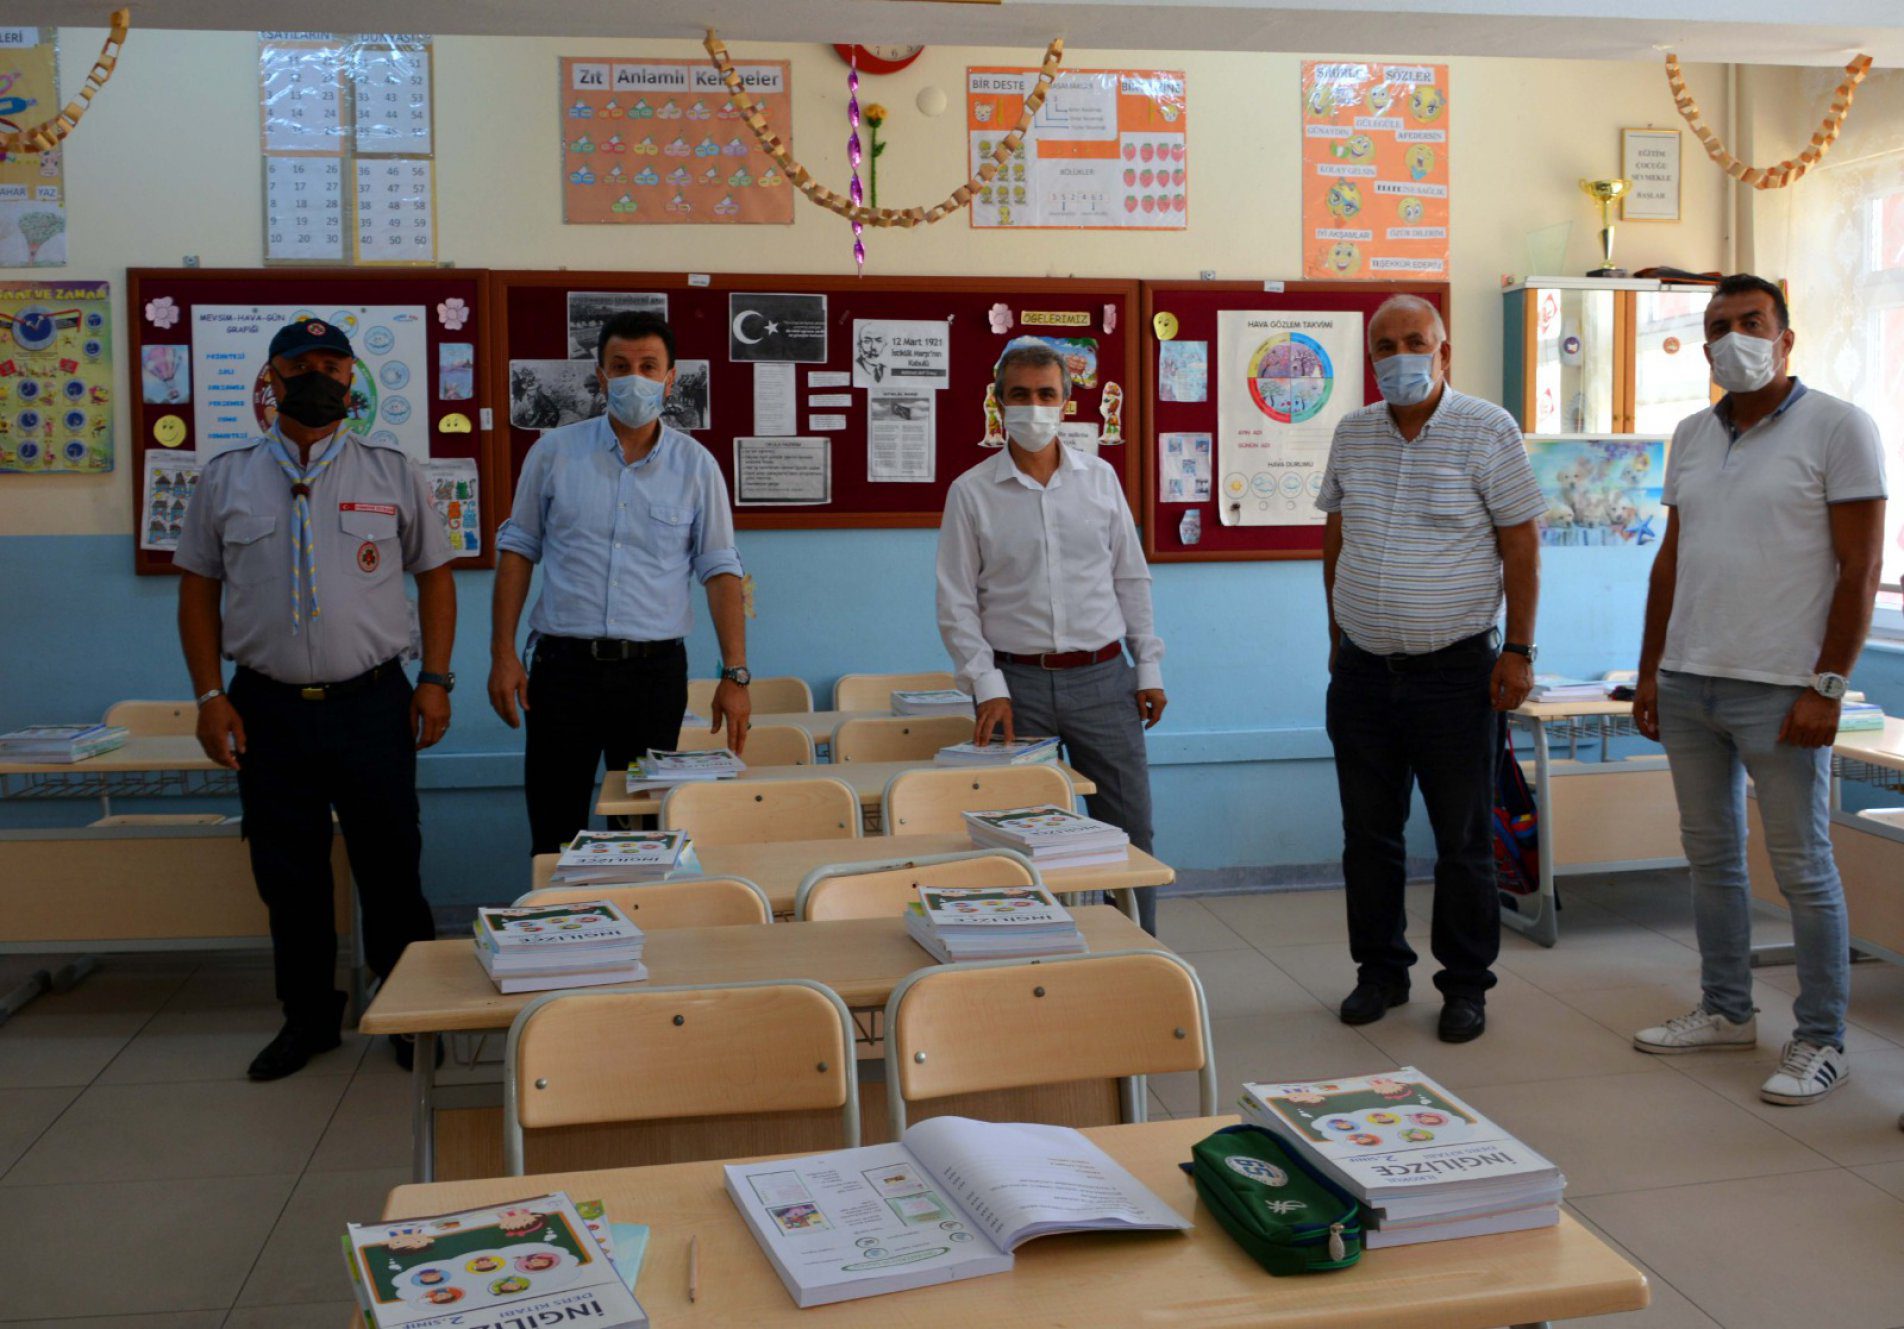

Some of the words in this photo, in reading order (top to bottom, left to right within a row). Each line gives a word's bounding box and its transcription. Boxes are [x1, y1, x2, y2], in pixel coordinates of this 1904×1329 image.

[411, 76, 422, 85] 52
[972, 79, 989, 89] BİR
[993, 80, 1024, 90] DESTE
[322, 92, 334, 100] 23
[358, 93, 369, 101] 33
[385, 93, 396, 101] 43
[411, 93, 423, 101] 53
[291, 110, 302, 118] 14
[324, 110, 336, 118] 24
[358, 110, 370, 118] 34
[385, 110, 397, 119] 44
[411, 111, 423, 119] 54
[269, 165, 275, 174] 6
[293, 165, 304, 174] 16
[326, 165, 338, 174] 26
[359, 167, 370, 176] 36
[386, 167, 399, 176] 46
[412, 167, 424, 176] 56
[270, 182, 276, 191] 7
[295, 182, 306, 191] 17
[326, 182, 338, 191] 27
[359, 184, 370, 193] 37
[387, 184, 399, 193] 47
[413, 184, 425, 193] 57
[270, 200, 276, 208] 8
[296, 200, 307, 208] 18
[326, 200, 338, 208] 28
[360, 202, 371, 210] 38
[388, 202, 400, 210] 48
[414, 202, 425, 210] 58
[270, 217, 277, 226] 9
[296, 217, 308, 226] 19
[326, 217, 338, 226] 29
[360, 219, 371, 227] 39
[389, 219, 400, 227] 49
[414, 219, 426, 227] 59
[271, 234, 282, 243] 10
[298, 234, 310, 243] 20
[326, 234, 338, 243] 30
[360, 236, 372, 245] 40
[389, 236, 401, 245] 50
[414, 236, 427, 245] 60
[1270, 320, 1300, 328] GÖZLEM
[892, 337, 902, 346] 12
[903, 337, 922, 346] Mart
[925, 338, 943, 346] 1921
[1371, 1151, 1517, 1177] İNGİLİZCE
